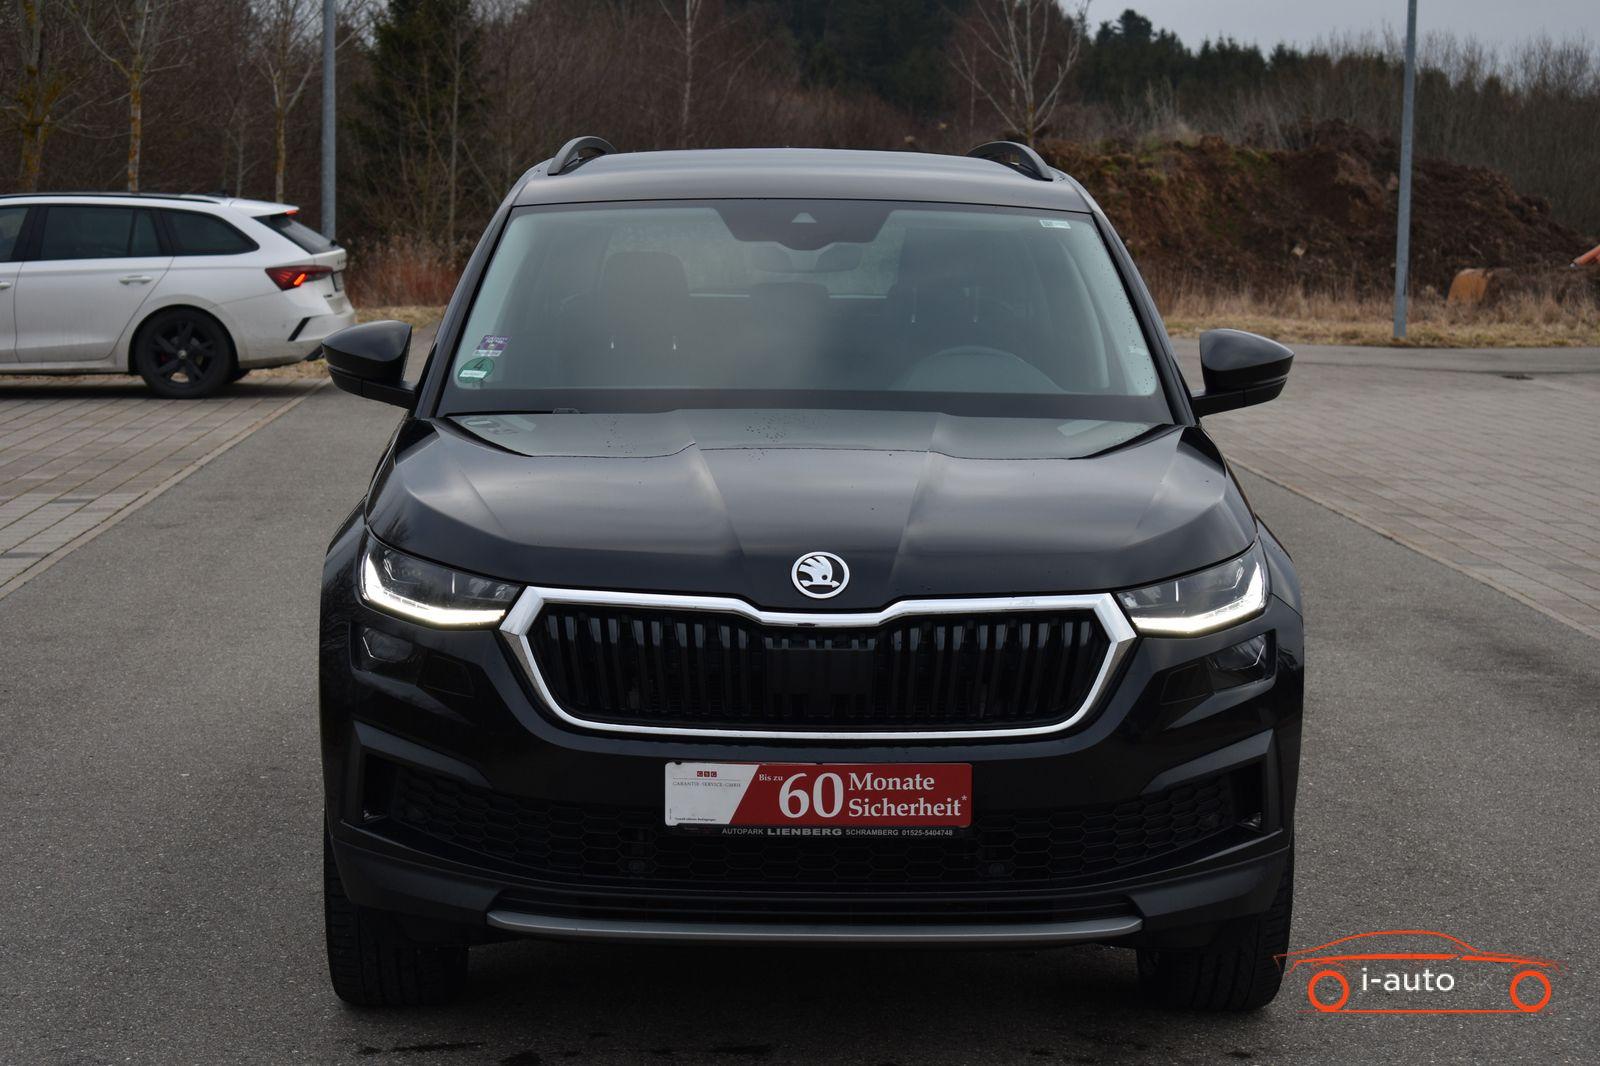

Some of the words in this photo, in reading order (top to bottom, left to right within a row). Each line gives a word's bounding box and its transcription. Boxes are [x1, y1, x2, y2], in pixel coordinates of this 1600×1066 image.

[848, 772, 936, 791] Monate
[758, 773, 772, 782] Bis
[778, 772, 844, 819] 60
[721, 827, 764, 836] AUTOPARK
[766, 827, 843, 837] LIENBERG
[845, 828, 899, 837] SCHRAMBERG
[901, 828, 954, 837] 01525-5404748
